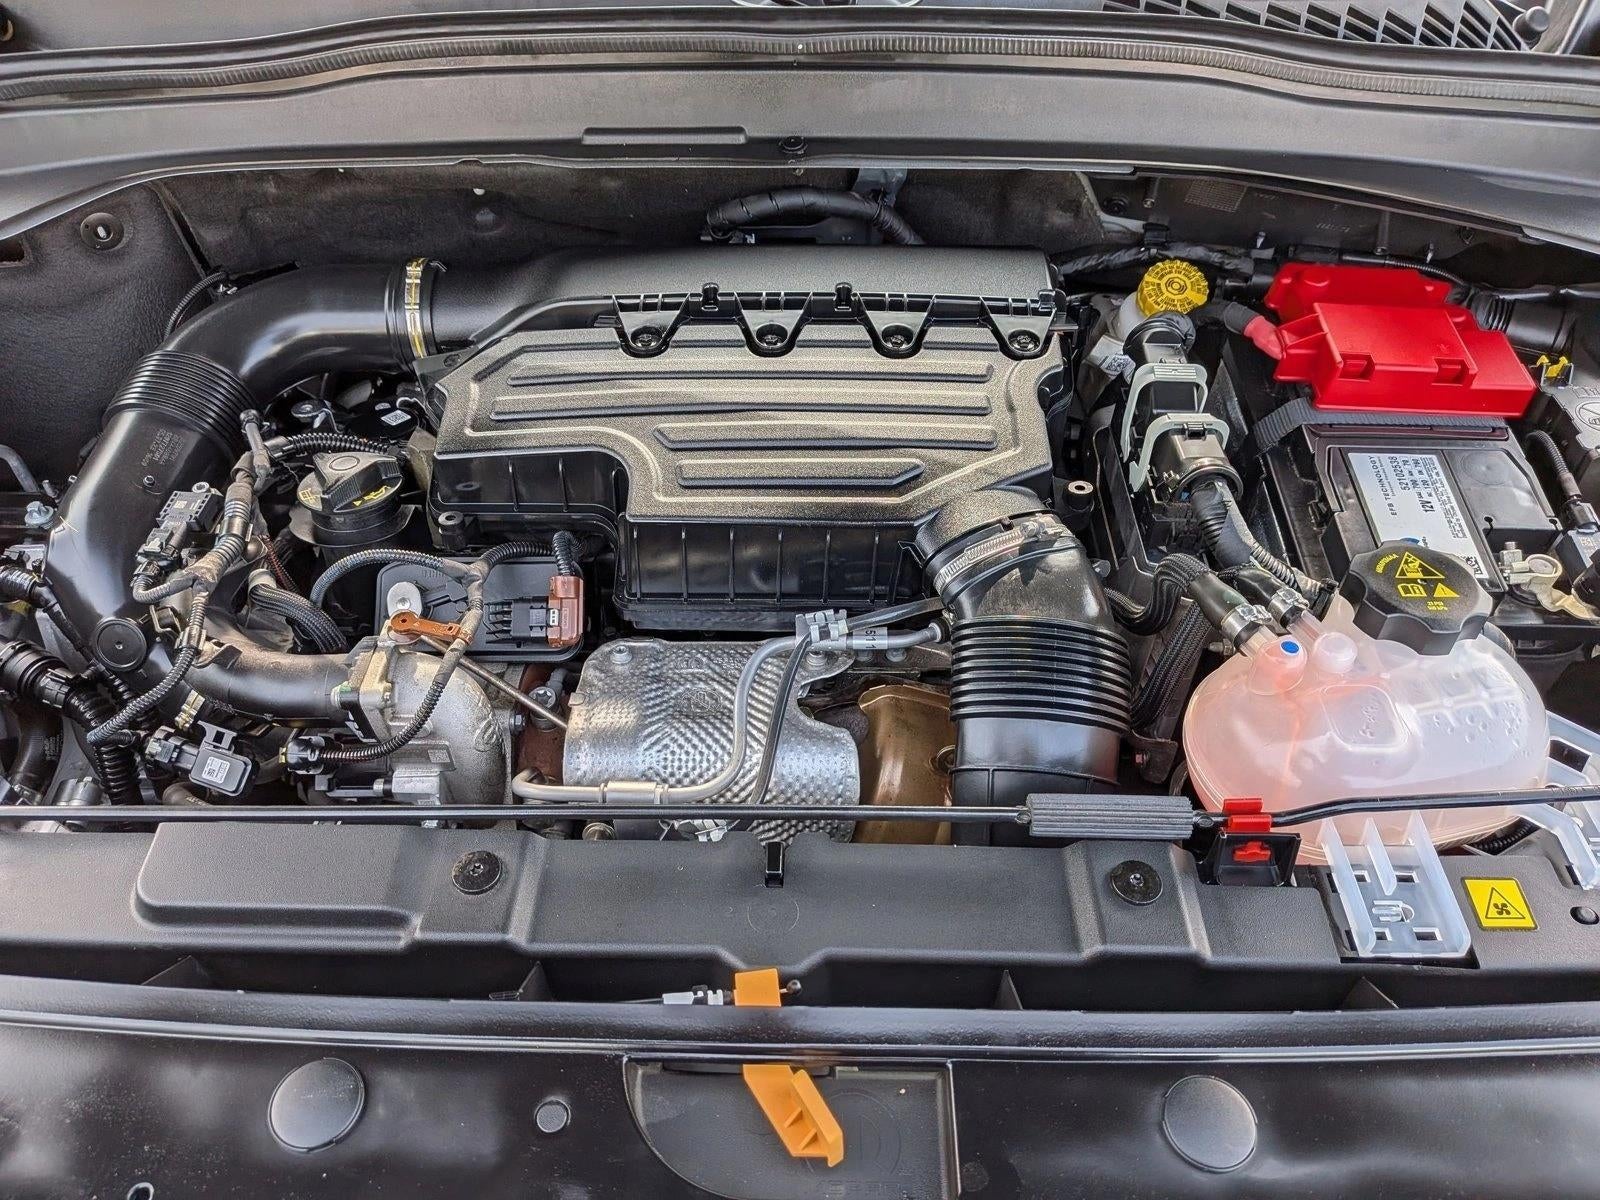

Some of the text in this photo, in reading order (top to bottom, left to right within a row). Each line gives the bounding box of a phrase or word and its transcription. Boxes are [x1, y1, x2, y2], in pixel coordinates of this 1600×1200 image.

[1368, 456, 1391, 501] TECHNOLOGY
[1388, 456, 1411, 491] 52102538
[1387, 503, 1398, 516] EFB
[1419, 500, 1436, 513] 12V
[866, 630, 876, 649] 511
